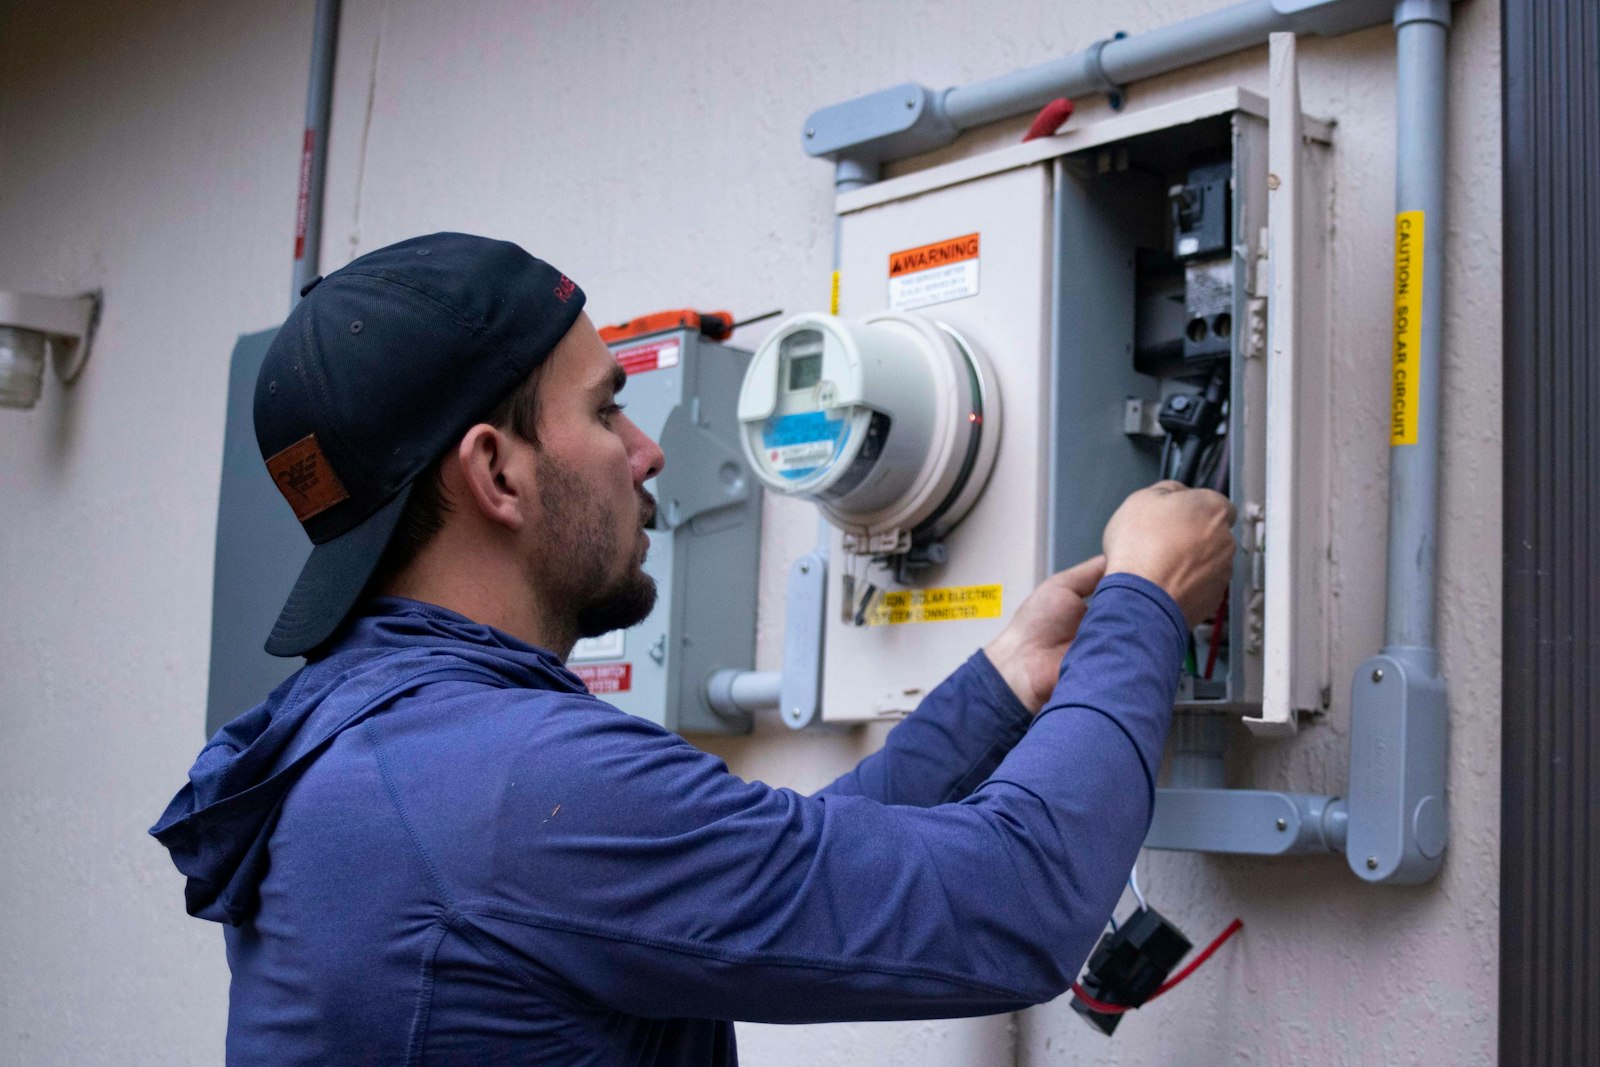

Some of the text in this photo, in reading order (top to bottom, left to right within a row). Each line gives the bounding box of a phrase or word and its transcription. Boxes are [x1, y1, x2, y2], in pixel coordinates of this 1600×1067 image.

[904, 239, 978, 269] WARNING
[1396, 304, 1409, 364] SOLAR
[1392, 368, 1407, 438] CIRCUIT
[948, 588, 999, 603] ELECTRIC
[917, 605, 978, 621] CONNECTED
